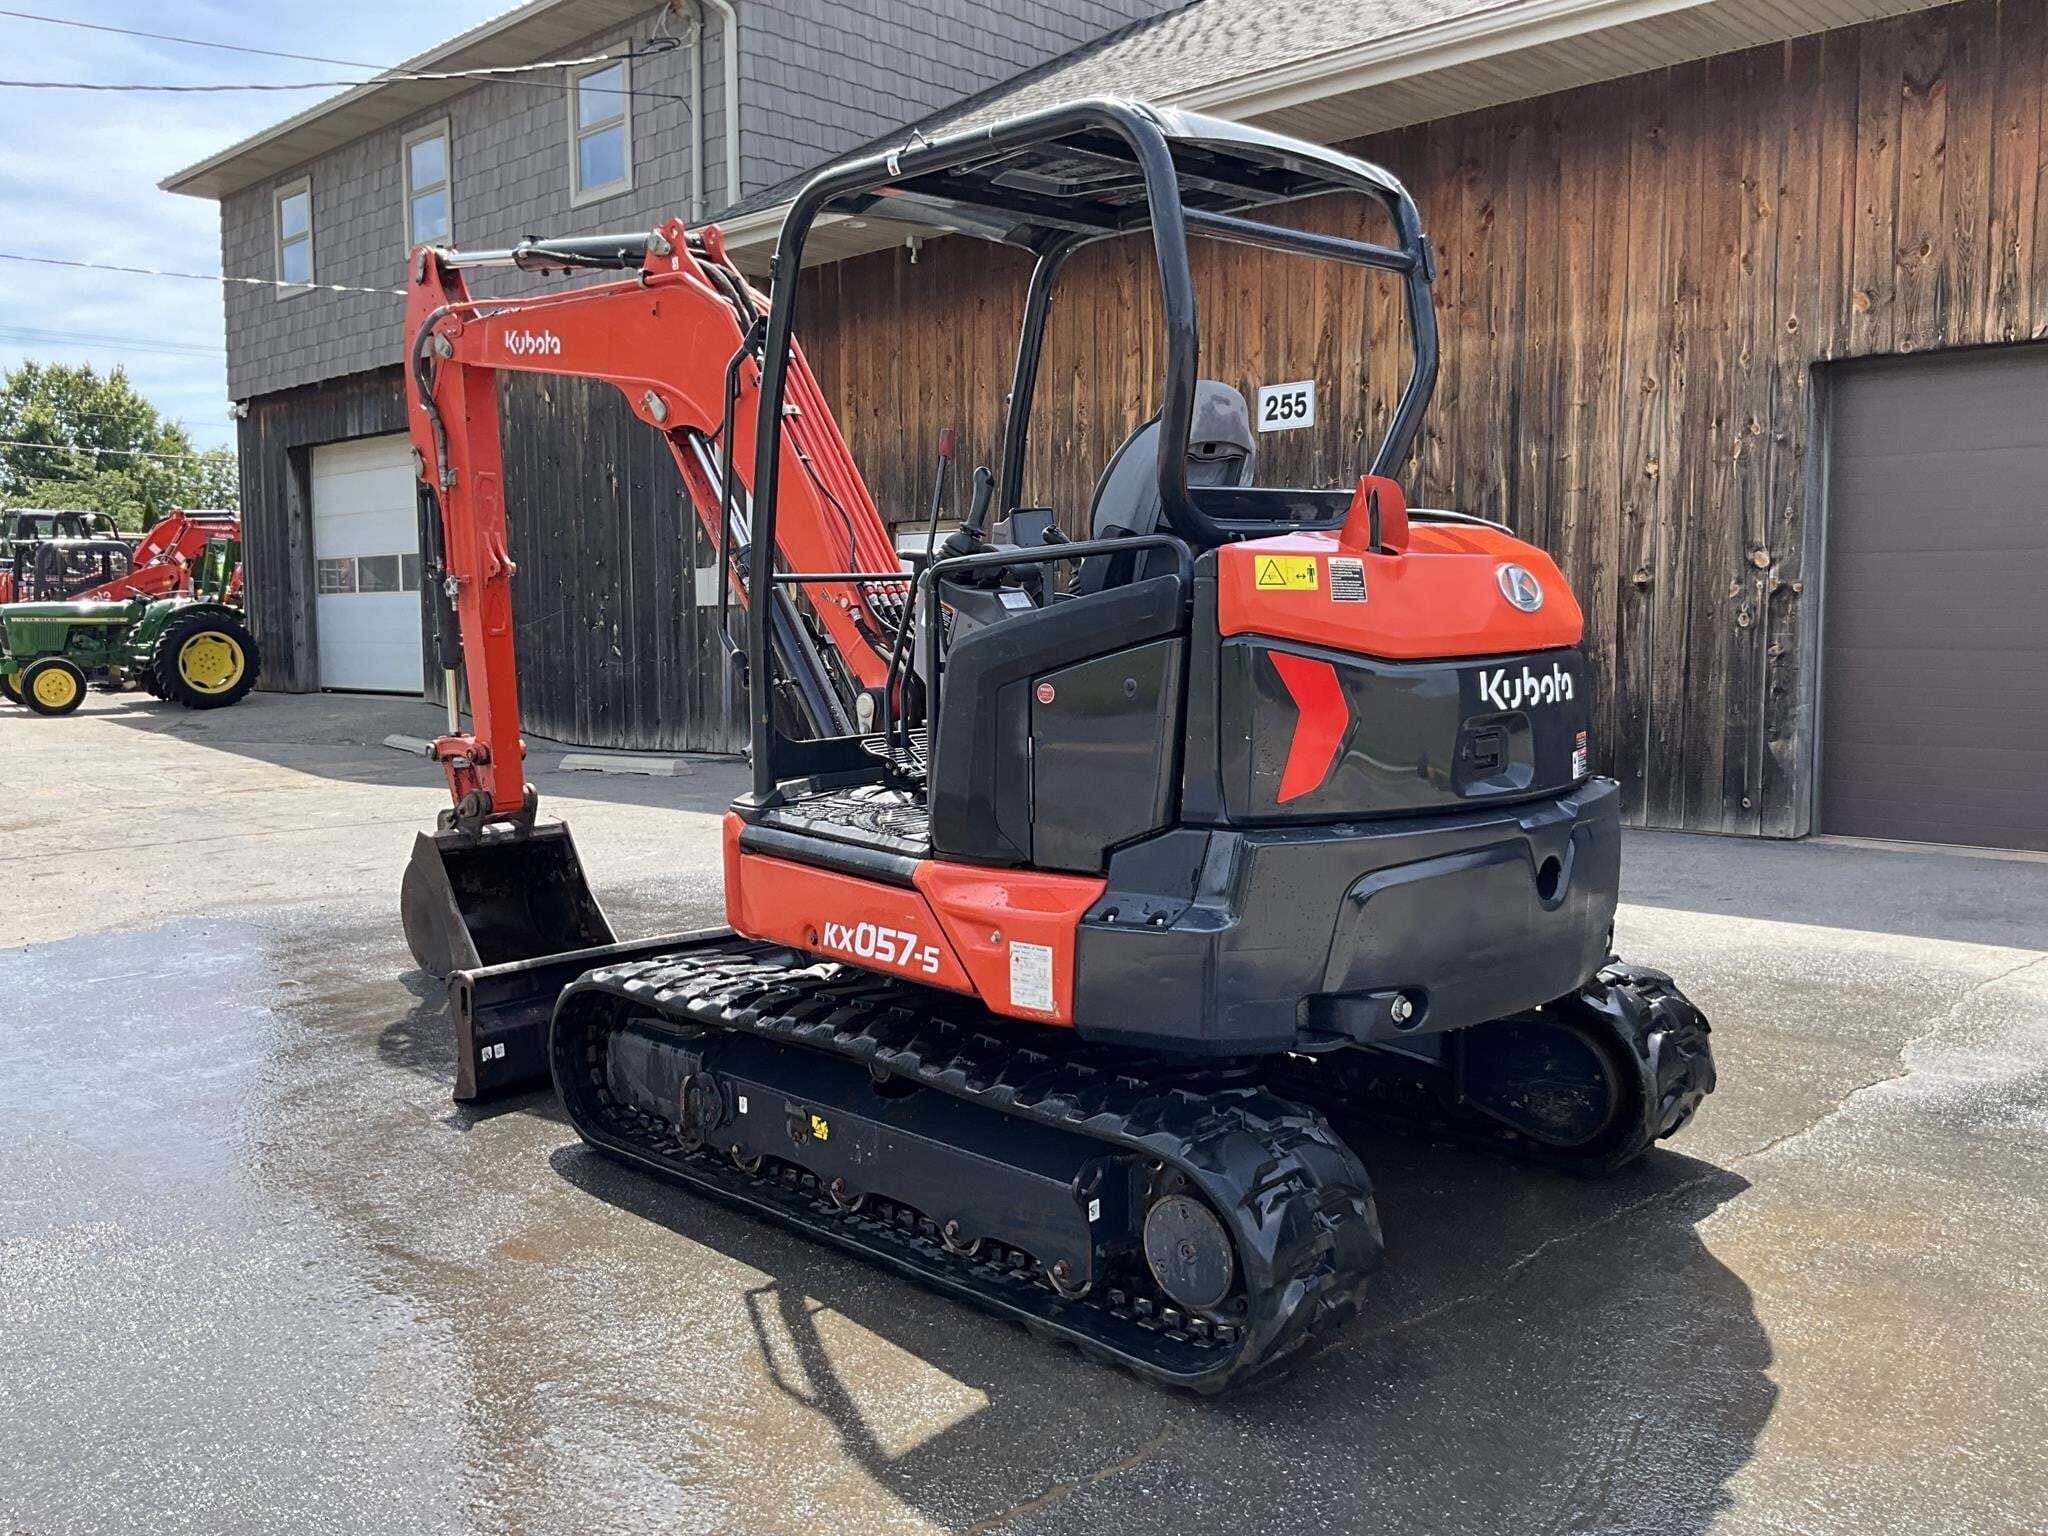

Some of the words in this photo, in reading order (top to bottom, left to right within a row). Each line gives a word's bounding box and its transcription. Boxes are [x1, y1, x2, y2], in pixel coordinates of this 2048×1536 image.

[504, 329, 561, 355] Kubota
[1265, 391, 1307, 421] 255
[1479, 662, 1574, 710] Kubota
[823, 921, 940, 974] KX057-5
